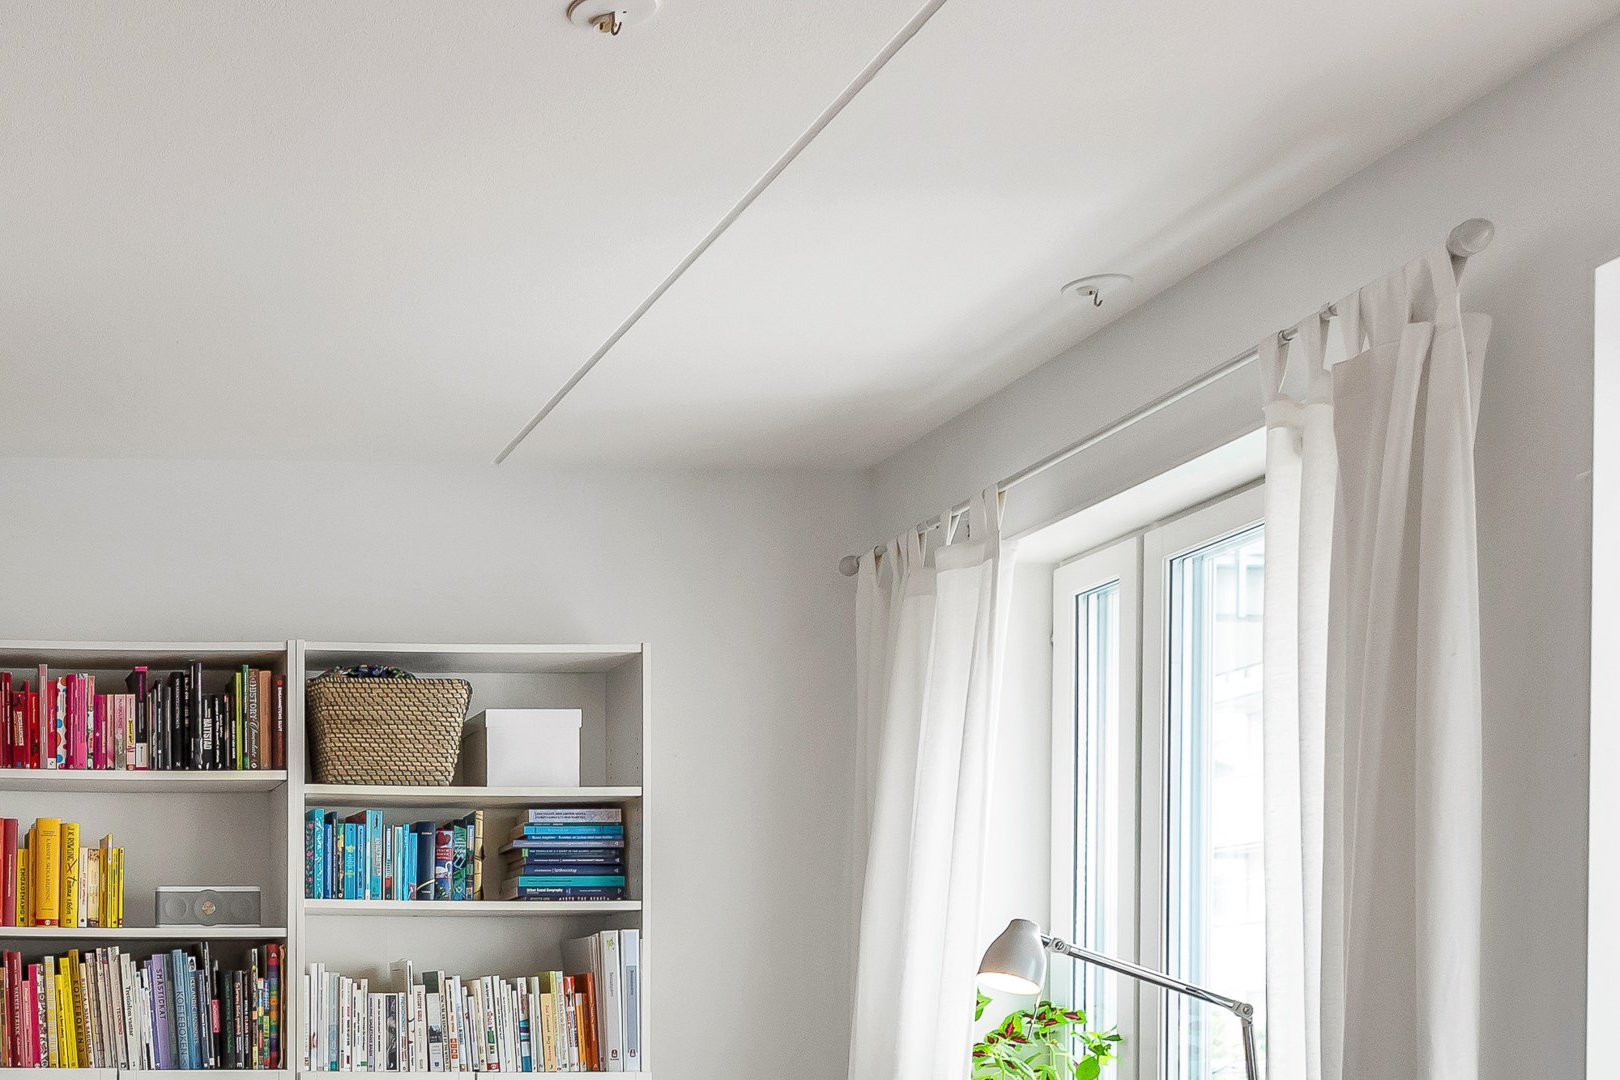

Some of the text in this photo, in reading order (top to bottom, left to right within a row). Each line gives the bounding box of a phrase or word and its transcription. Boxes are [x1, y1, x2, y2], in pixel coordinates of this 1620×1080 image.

[203, 718, 212, 750] NATTSTAD
[249, 684, 260, 758] HISTORY Chocolate
[67, 837, 75, 862] ROWLING
[73, 980, 84, 1044] KOFTEBOKEN
[176, 991, 188, 1055] KOFTEBOKEN
